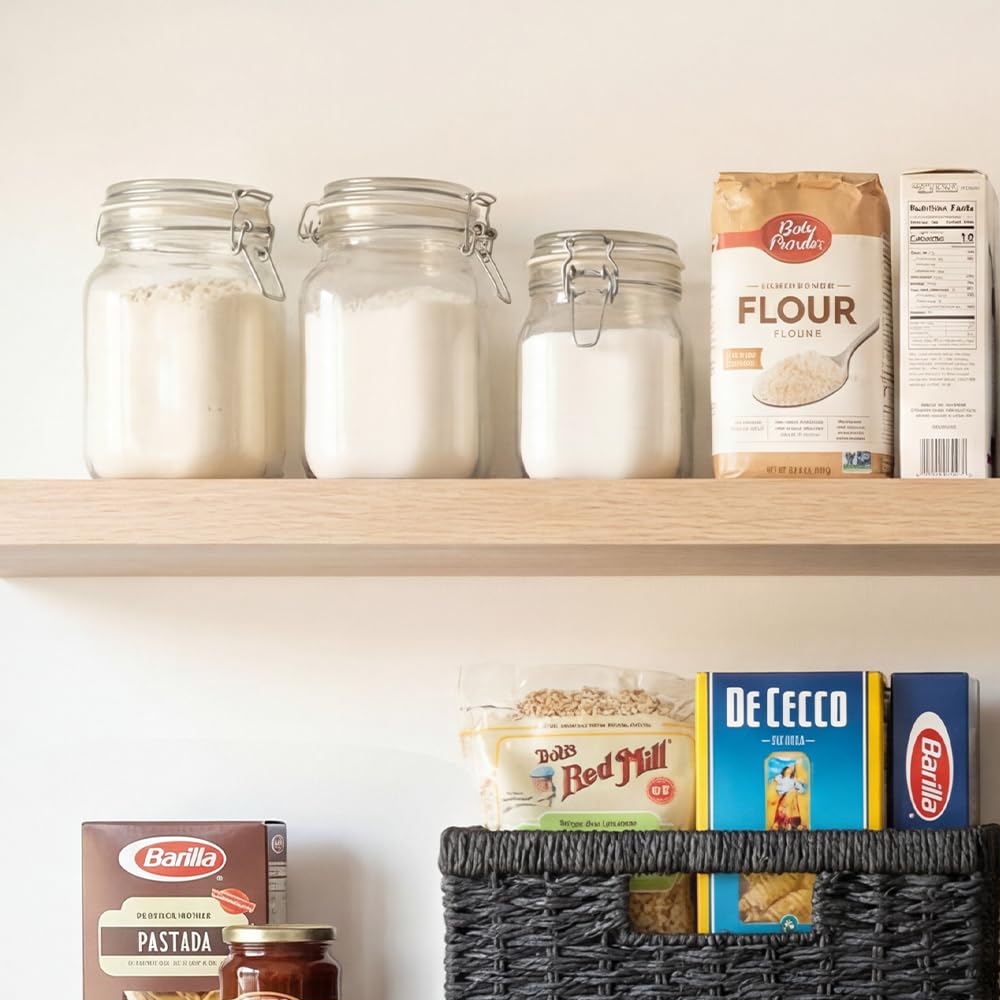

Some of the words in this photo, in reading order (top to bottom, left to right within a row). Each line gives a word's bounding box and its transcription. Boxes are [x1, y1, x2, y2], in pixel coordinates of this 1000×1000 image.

[738, 296, 857, 324] FLOUR
[561, 752, 614, 801] Red
[615, 739, 668, 787] Mill
[921, 737, 943, 814] Barilla
[143, 847, 216, 868] Barilla
[138, 931, 212, 952] PASTADA
